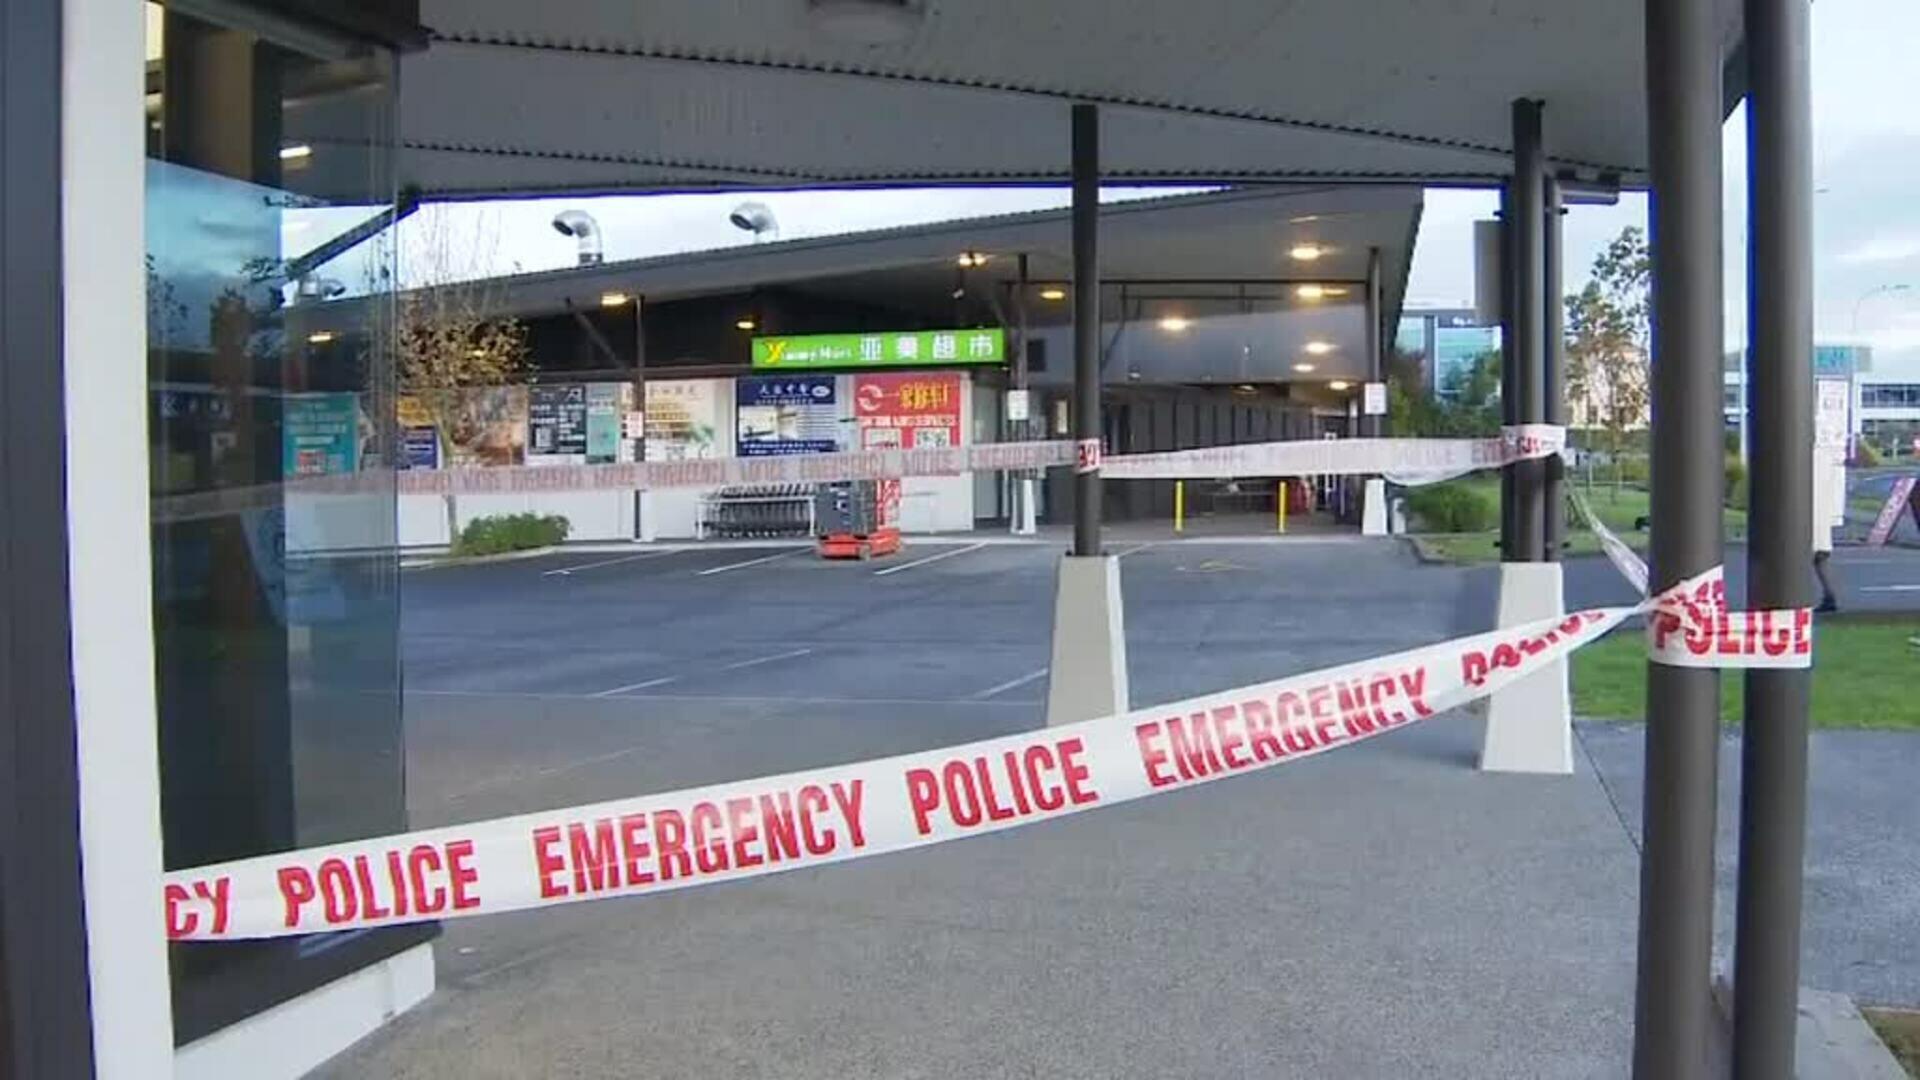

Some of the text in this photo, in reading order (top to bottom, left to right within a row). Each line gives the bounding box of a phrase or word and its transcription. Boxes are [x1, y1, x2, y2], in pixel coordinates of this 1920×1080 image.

[163, 876, 231, 939] CY
[276, 839, 481, 928] POLICE
[532, 778, 866, 899] EMERGENCY
[905, 736, 1099, 836] POLICE
[1135, 665, 1434, 788] EMERGENCY
